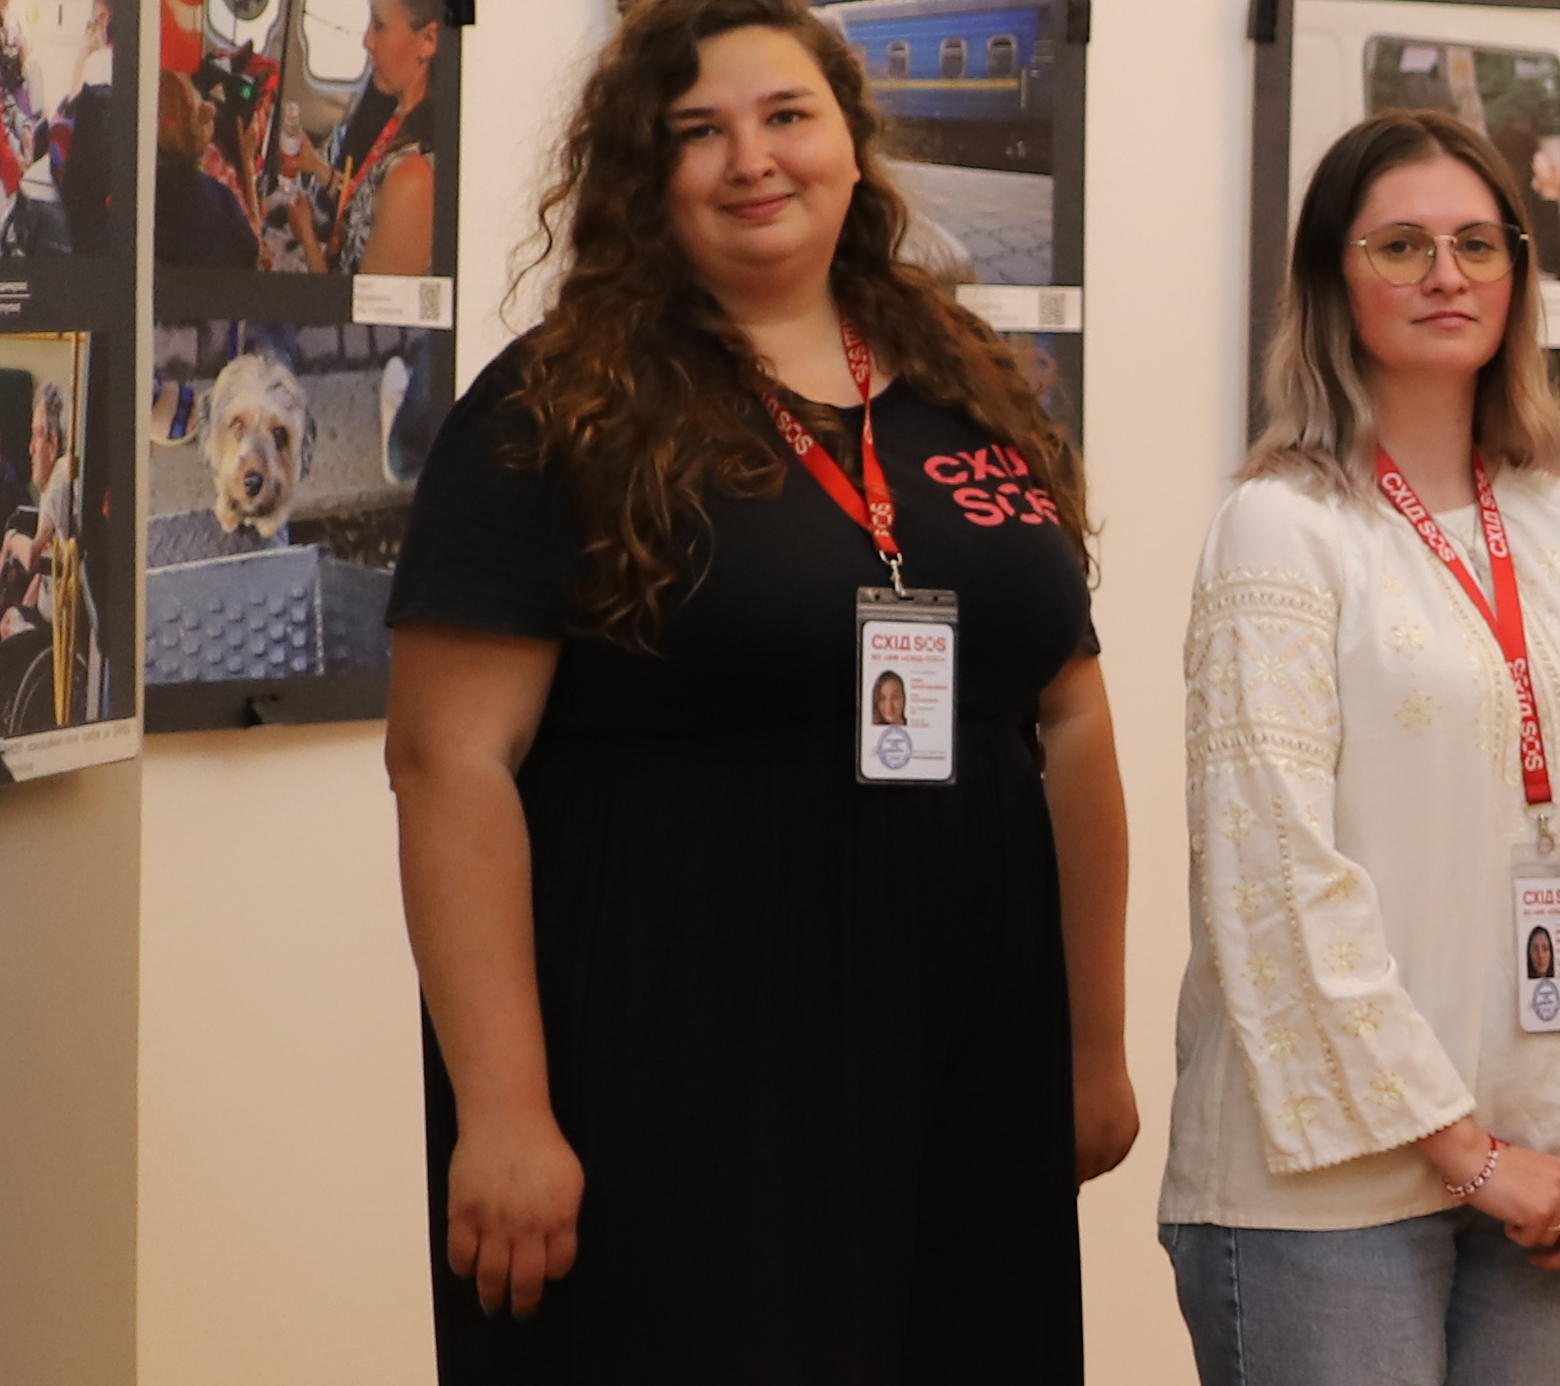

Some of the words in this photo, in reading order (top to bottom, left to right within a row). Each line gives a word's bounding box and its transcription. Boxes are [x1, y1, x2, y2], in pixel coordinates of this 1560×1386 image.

[776, 410, 814, 455] SOS
[1381, 472, 1428, 522] СХІД
[1417, 520, 1456, 562] SOS
[1482, 509, 1508, 558] СХІД
[871, 634, 910, 650] СХІД
[913, 636, 947, 652] SOS
[1521, 720, 1544, 772] SOS
[1523, 889, 1554, 905] СХІД
